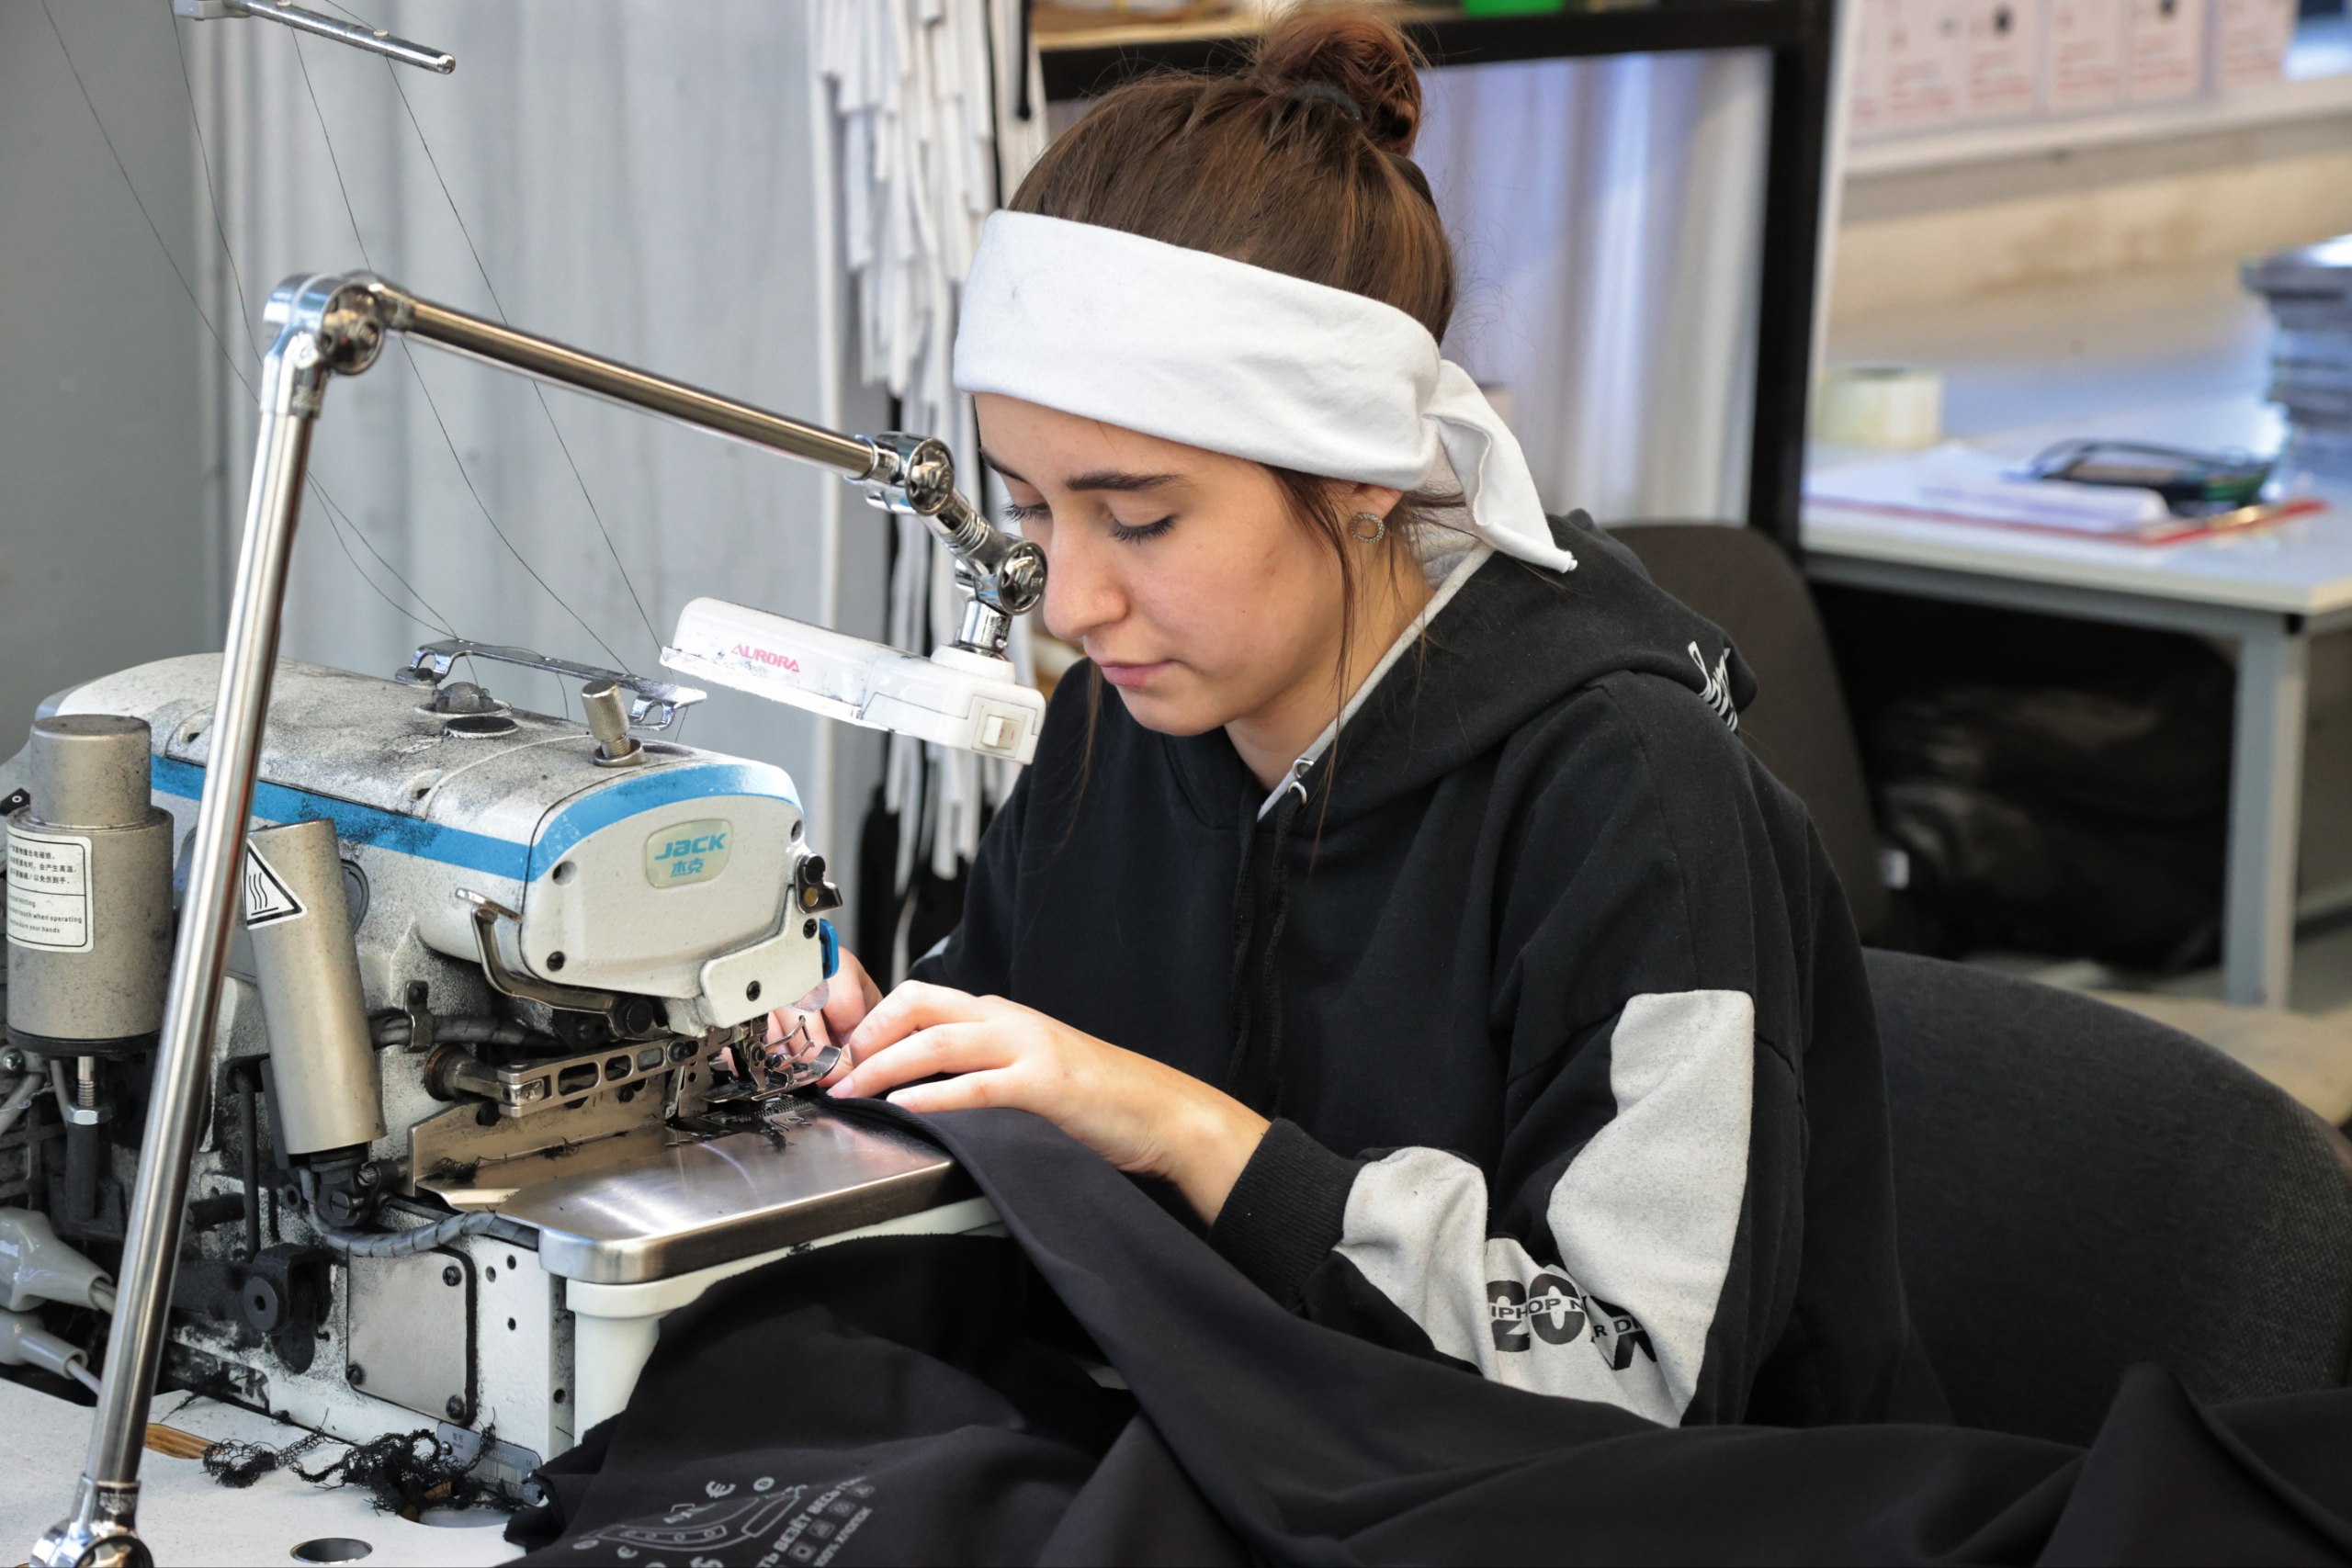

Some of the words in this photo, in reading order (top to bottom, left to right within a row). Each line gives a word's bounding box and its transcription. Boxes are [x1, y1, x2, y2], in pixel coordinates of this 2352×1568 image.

[730, 643, 800, 673] AURORA
[670, 857, 705, 878] 杰克
[33, 912, 49, 920] when
[50, 915, 83, 924] operating
